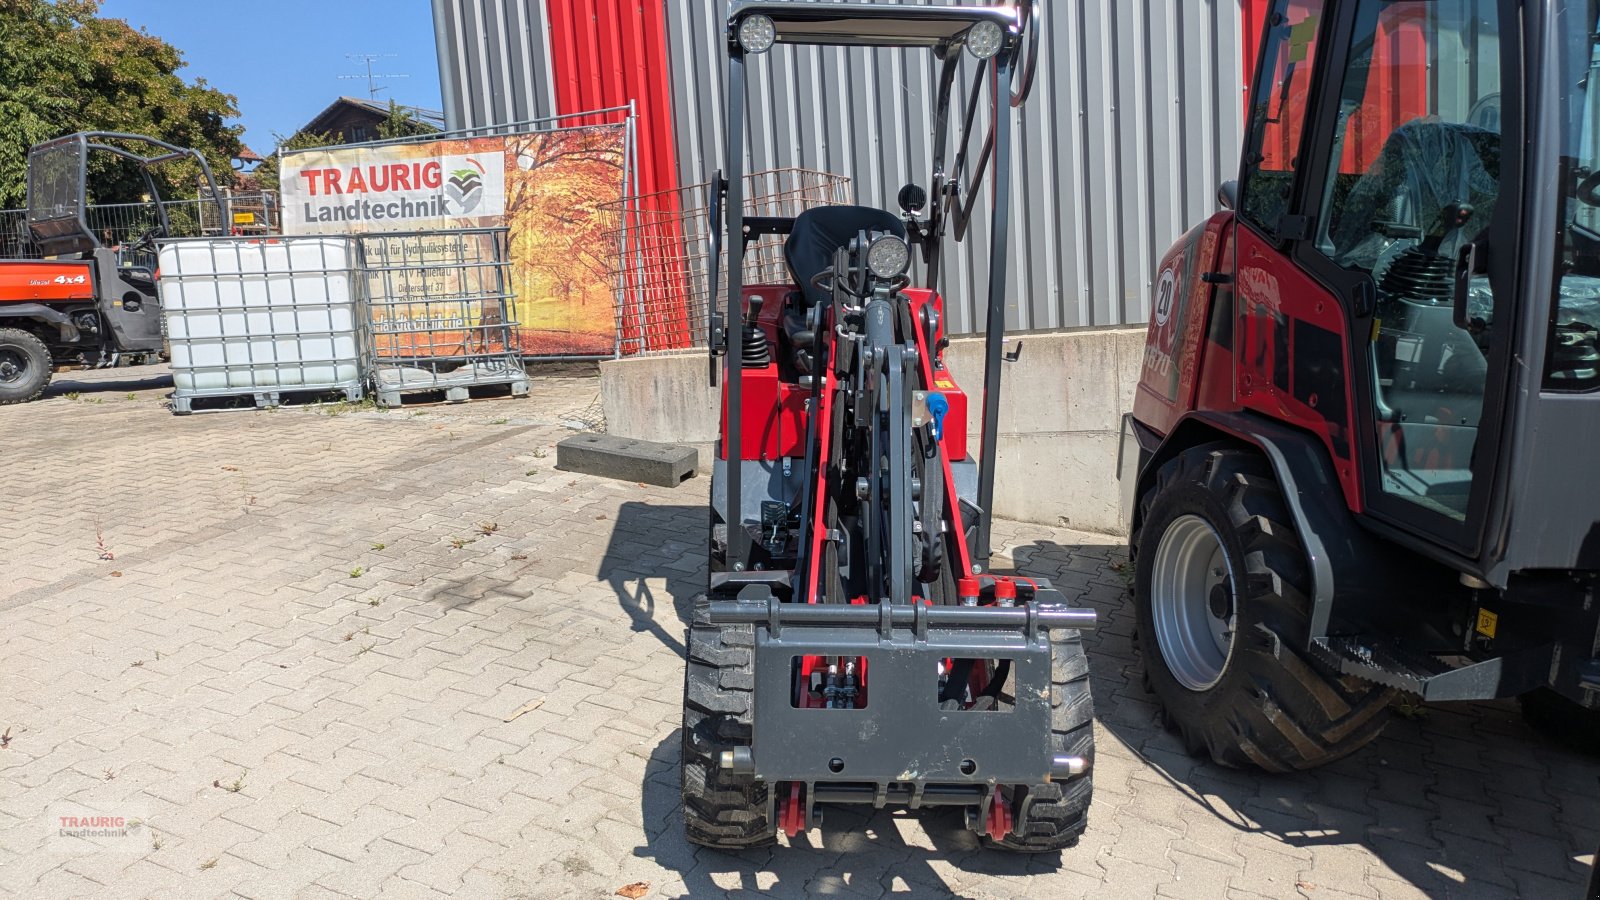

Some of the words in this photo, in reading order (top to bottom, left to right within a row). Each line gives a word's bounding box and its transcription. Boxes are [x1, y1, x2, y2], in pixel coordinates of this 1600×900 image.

[300, 161, 442, 196] TRAURIG
[304, 195, 450, 223] Landtechnik
[390, 243, 400, 255] für
[403, 242, 468, 257] Hydauliksystee
[54, 274, 86, 285] 4x4
[399, 268, 414, 279] AV
[398, 282, 434, 293] Dietersdrf
[435, 282, 444, 292] 37
[1158, 279, 1172, 316] 20
